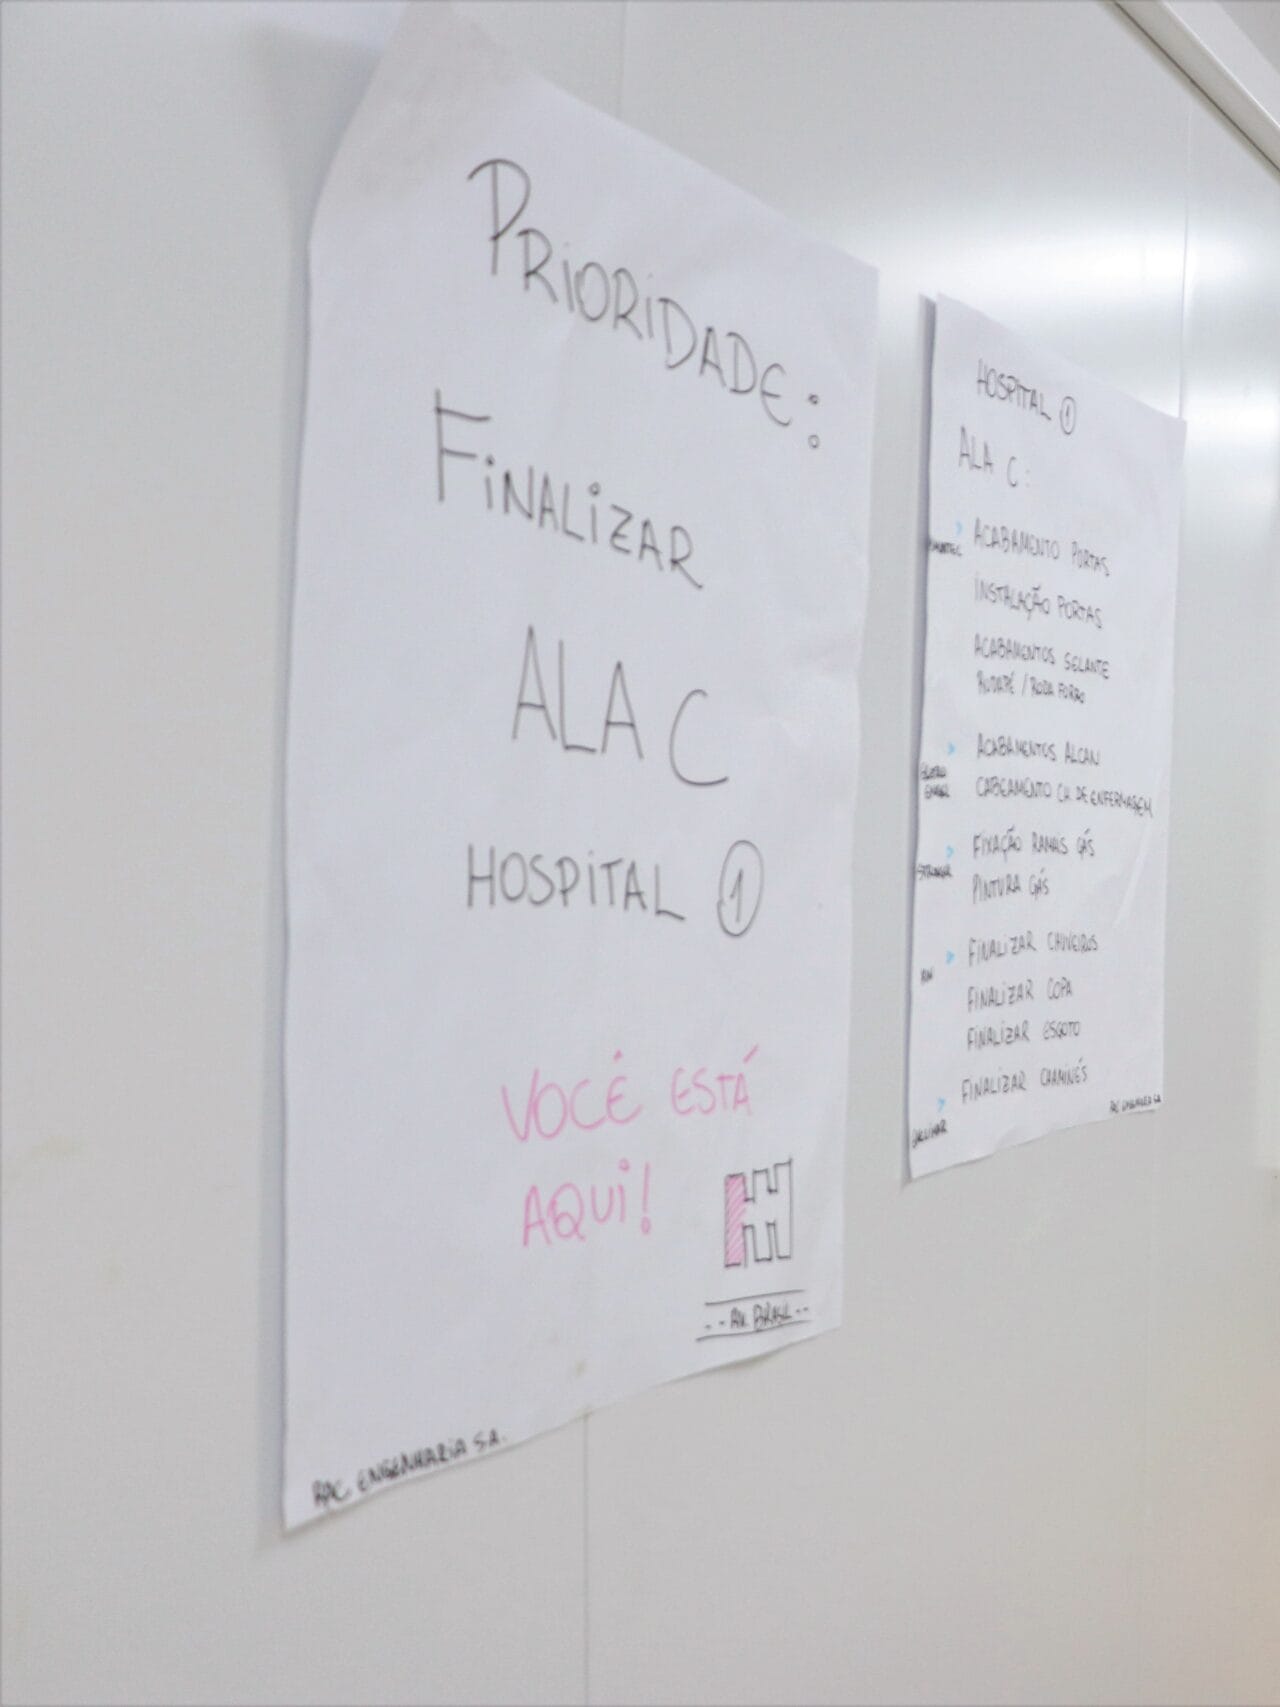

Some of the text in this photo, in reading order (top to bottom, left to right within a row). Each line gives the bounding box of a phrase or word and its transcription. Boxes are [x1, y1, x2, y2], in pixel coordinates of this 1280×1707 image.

[977, 358, 1052, 420] HOSPITAL
[959, 424, 994, 475] ALA
[433, 389, 704, 590] FINALIZAR
[975, 516, 1060, 560] ACABAMENTO
[1057, 594, 1103, 630] PORTAS
[974, 632, 1110, 680] ACABAMENTOS SELANTE
[511, 624, 728, 787] ALA C
[976, 732, 1057, 762] ACABAMENTOS
[467, 843, 686, 921] HOSPITAL
[972, 873, 1022, 904] PINTURA
[968, 931, 1037, 968] FINALIZAR
[967, 976, 1073, 1013] FINALIZAR COPA
[967, 1019, 1030, 1051] FINALIZAR
[671, 1044, 759, 1116] ESTÁ
[961, 1067, 1026, 1105] FINALIZAR
[523, 1158, 651, 1247] AQUI!
[357, 1438, 468, 1491] ENGENHARIA
